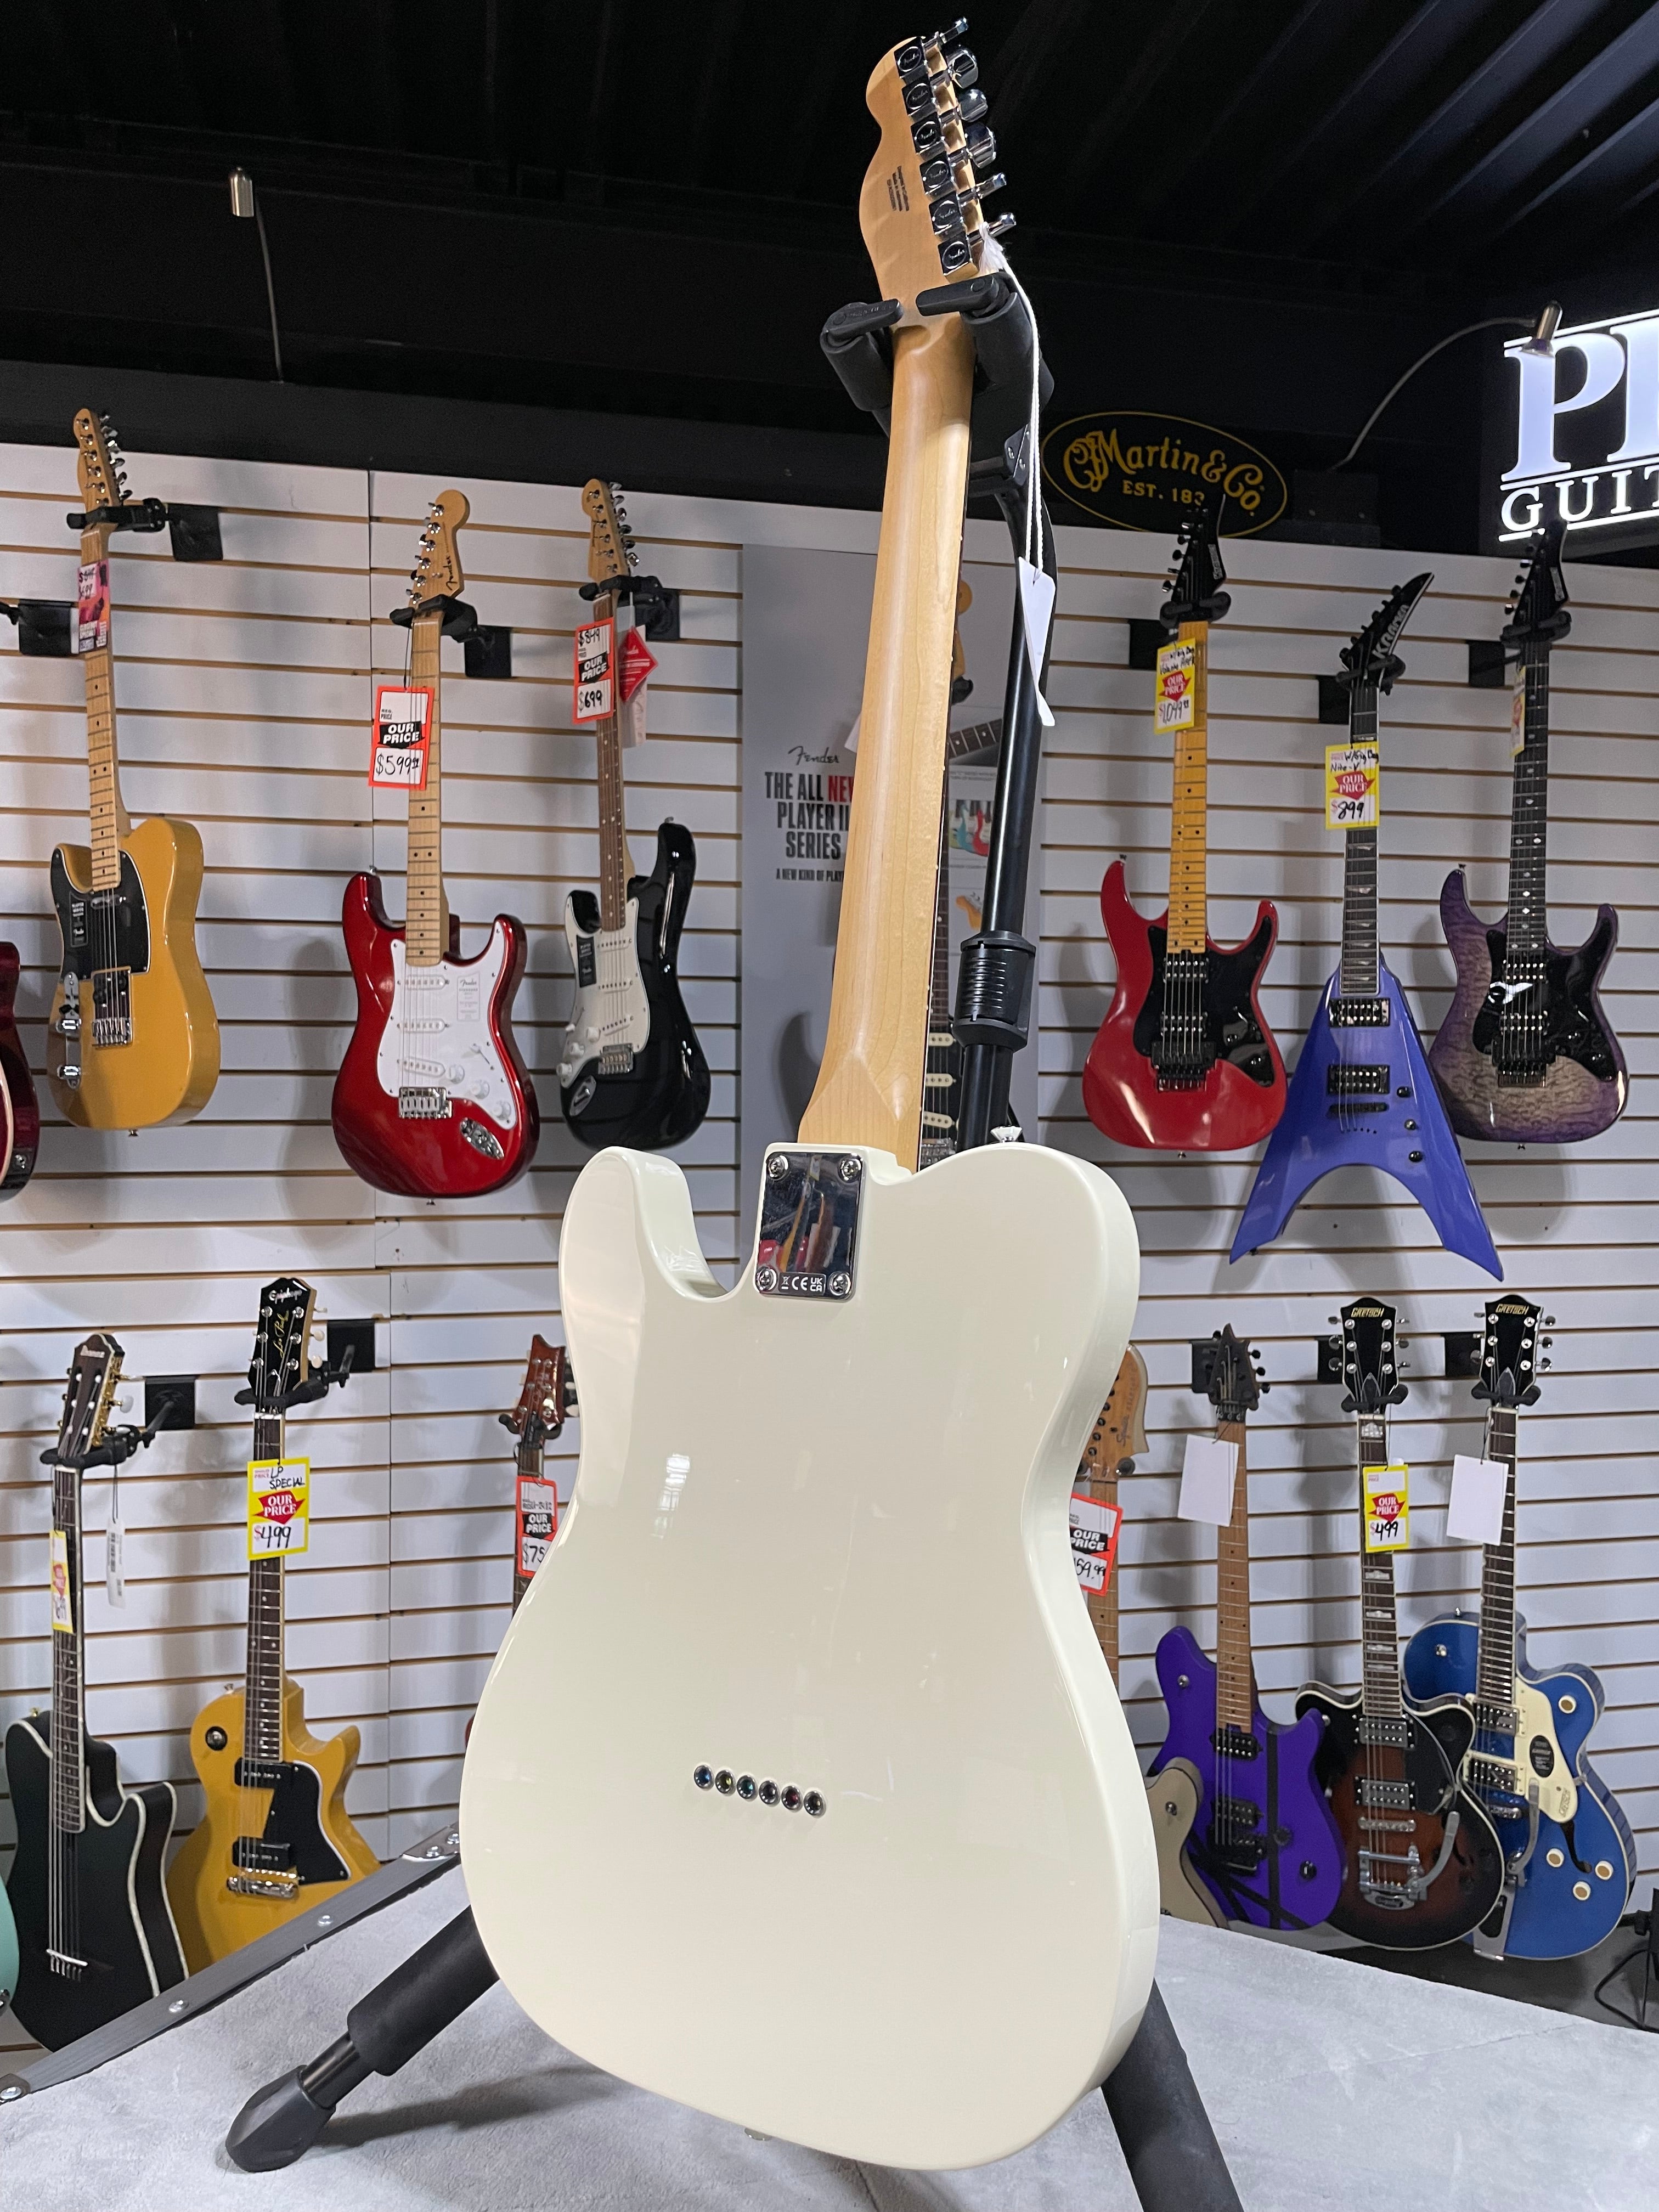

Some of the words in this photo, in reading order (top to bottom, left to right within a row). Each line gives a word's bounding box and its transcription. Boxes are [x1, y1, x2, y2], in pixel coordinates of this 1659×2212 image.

[1122, 479, 1164, 500] EST.
[1172, 487, 1205, 506] 183
[584, 656, 602, 670] OUR
[581, 663, 607, 682] PRICE
[1167, 674, 1183, 686] OUR
[579, 690, 602, 712] $699
[388, 723, 414, 735] OUR
[383, 731, 420, 744] PRICE
[788, 746, 839, 766] Fender
[1342, 774, 1364, 785] OUR
[765, 772, 793, 799] THE
[797, 774, 824, 801] ALL
[1340, 782, 1368, 793] PRICE
[777, 802, 836, 831] PLAYER
[786, 831, 842, 860] SERIES
[1351, 1307, 1385, 1318] GRETSCH
[1496, 1303, 1530, 1316] GRETSCH
[270, 1466, 284, 1479] LP
[269, 1476, 306, 1490] SPECIAL
[268, 1494, 293, 1506] OUR
[1378, 1497, 1397, 1506] OUR
[264, 1504, 297, 1517] PRICE
[1376, 1505, 1399, 1516] PRICE
[528, 1513, 548, 1523] OUR
[526, 1523, 552, 1533] PRICE
[1073, 1530, 1101, 1541] OUR
[1070, 1538, 1105, 1551] PRICE
